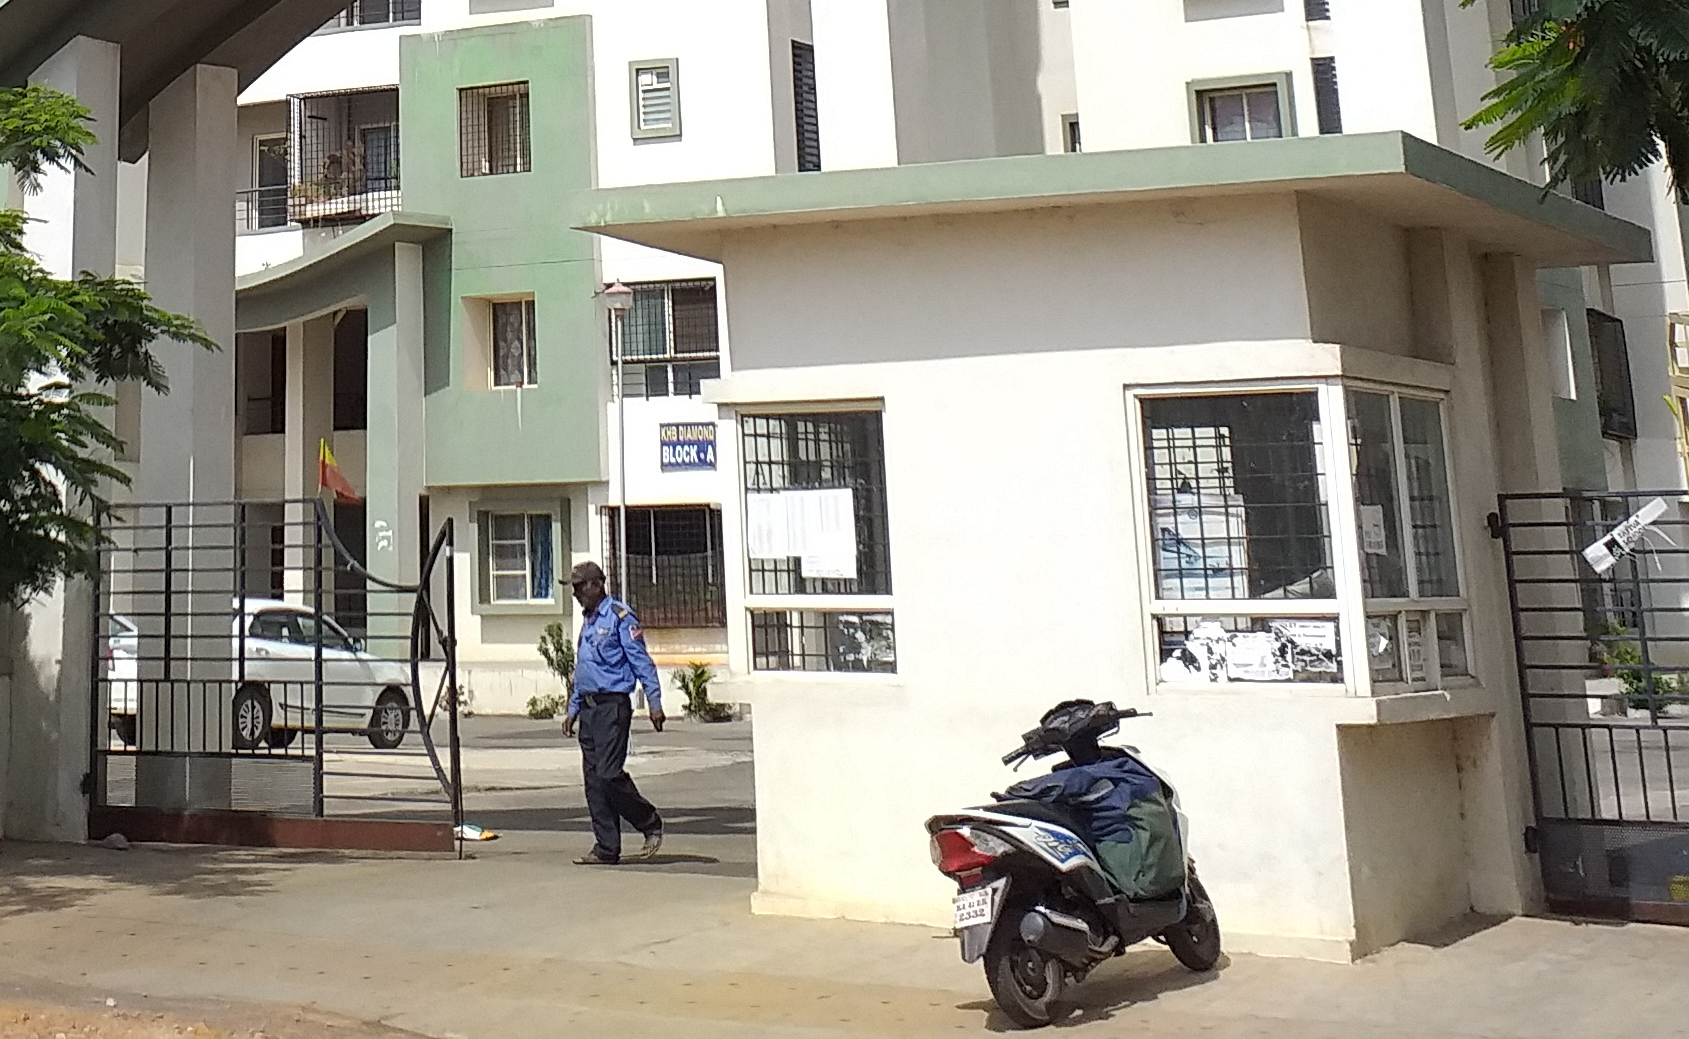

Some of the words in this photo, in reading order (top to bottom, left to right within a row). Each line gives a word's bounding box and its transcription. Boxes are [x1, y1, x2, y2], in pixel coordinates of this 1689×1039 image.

[661, 426, 677, 441] KHB
[678, 425, 714, 442] DIAMOND
[662, 444, 699, 464] BLOCK
[706, 445, 715, 463] A
[958, 908, 986, 922] 2332
